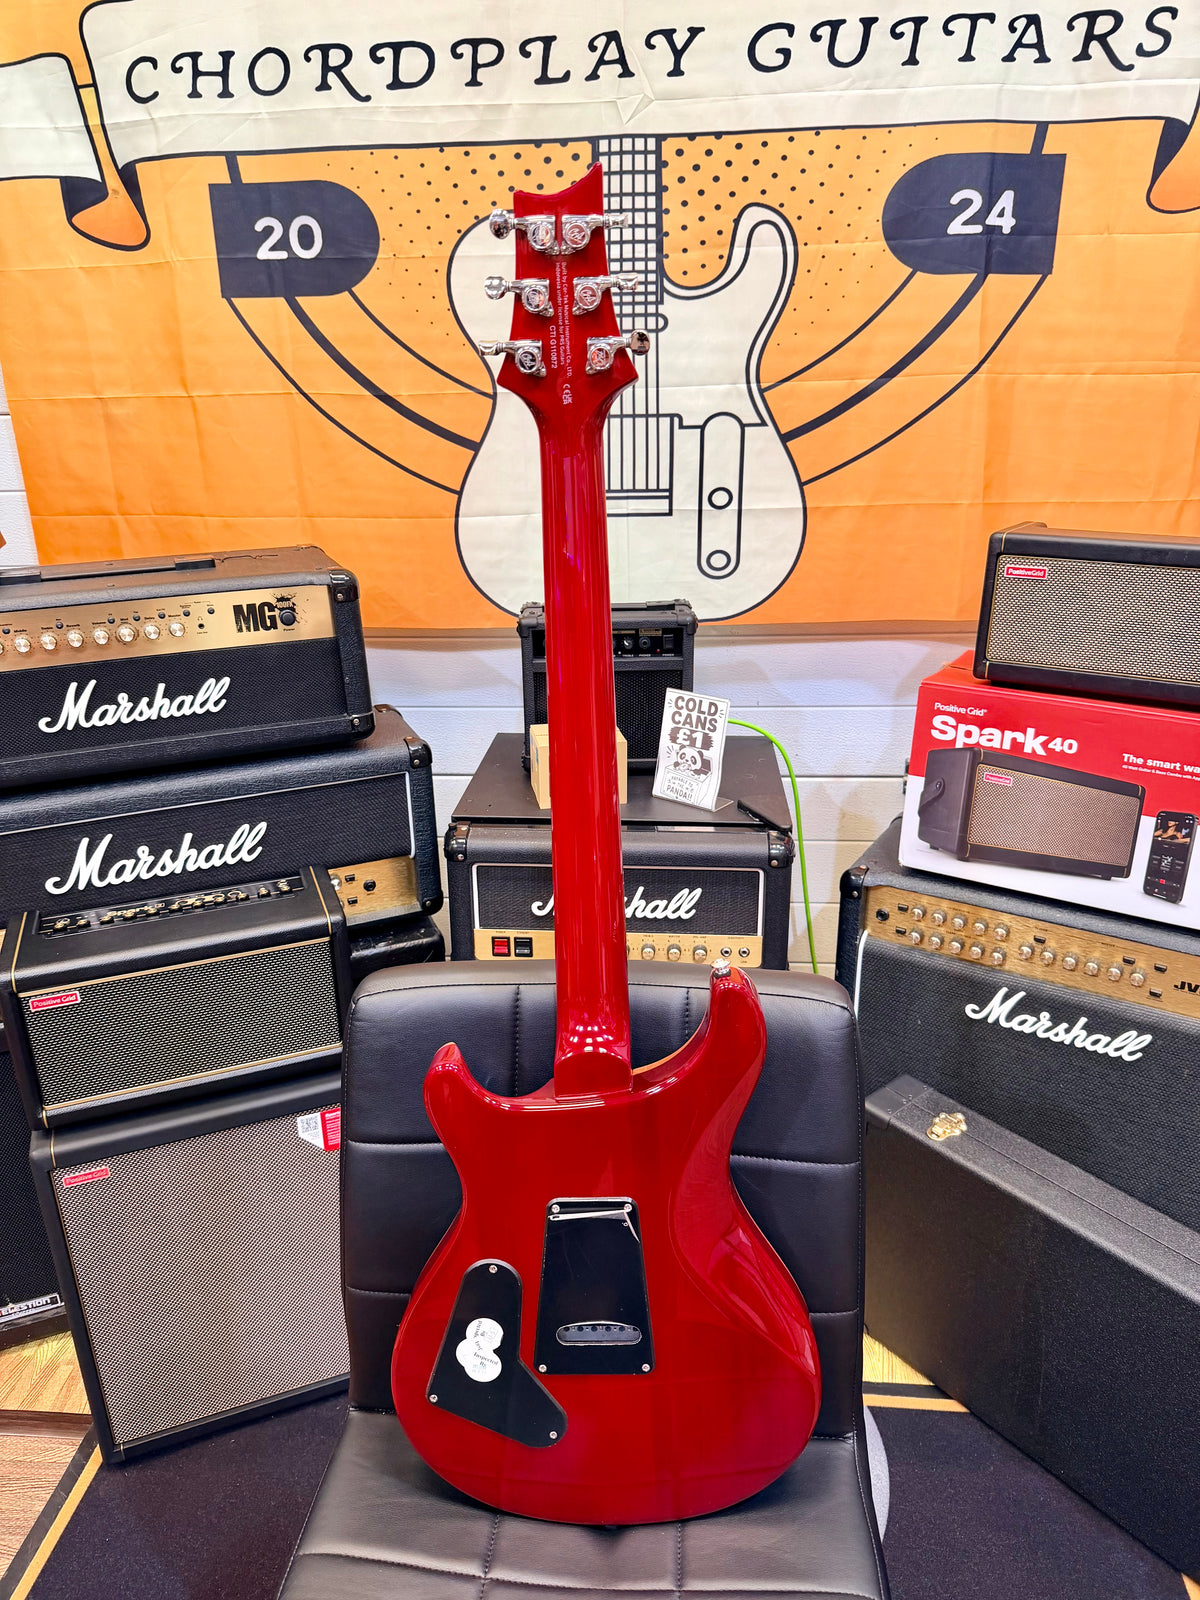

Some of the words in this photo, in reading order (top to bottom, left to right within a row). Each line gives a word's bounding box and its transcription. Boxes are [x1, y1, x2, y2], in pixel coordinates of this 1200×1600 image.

[126, 27, 705, 103] CHORDPLAY
[747, 6, 1178, 73] GUITARS
[946, 189, 1016, 235] 24
[254, 215, 323, 260] 20
[232, 601, 278, 633] MG
[38, 676, 231, 734] Marshall
[674, 695, 718, 717] COLD
[934, 702, 966, 714] Positive
[671, 710, 718, 733] CANS
[676, 728, 703, 748] £1
[1122, 753, 1144, 764] The
[1146, 759, 1181, 770] smart
[45, 821, 268, 895] Marshall
[33, 998, 60, 1007] Positive
[964, 986, 1153, 1062] Marshall
[65, 1174, 92, 1184] Positive
